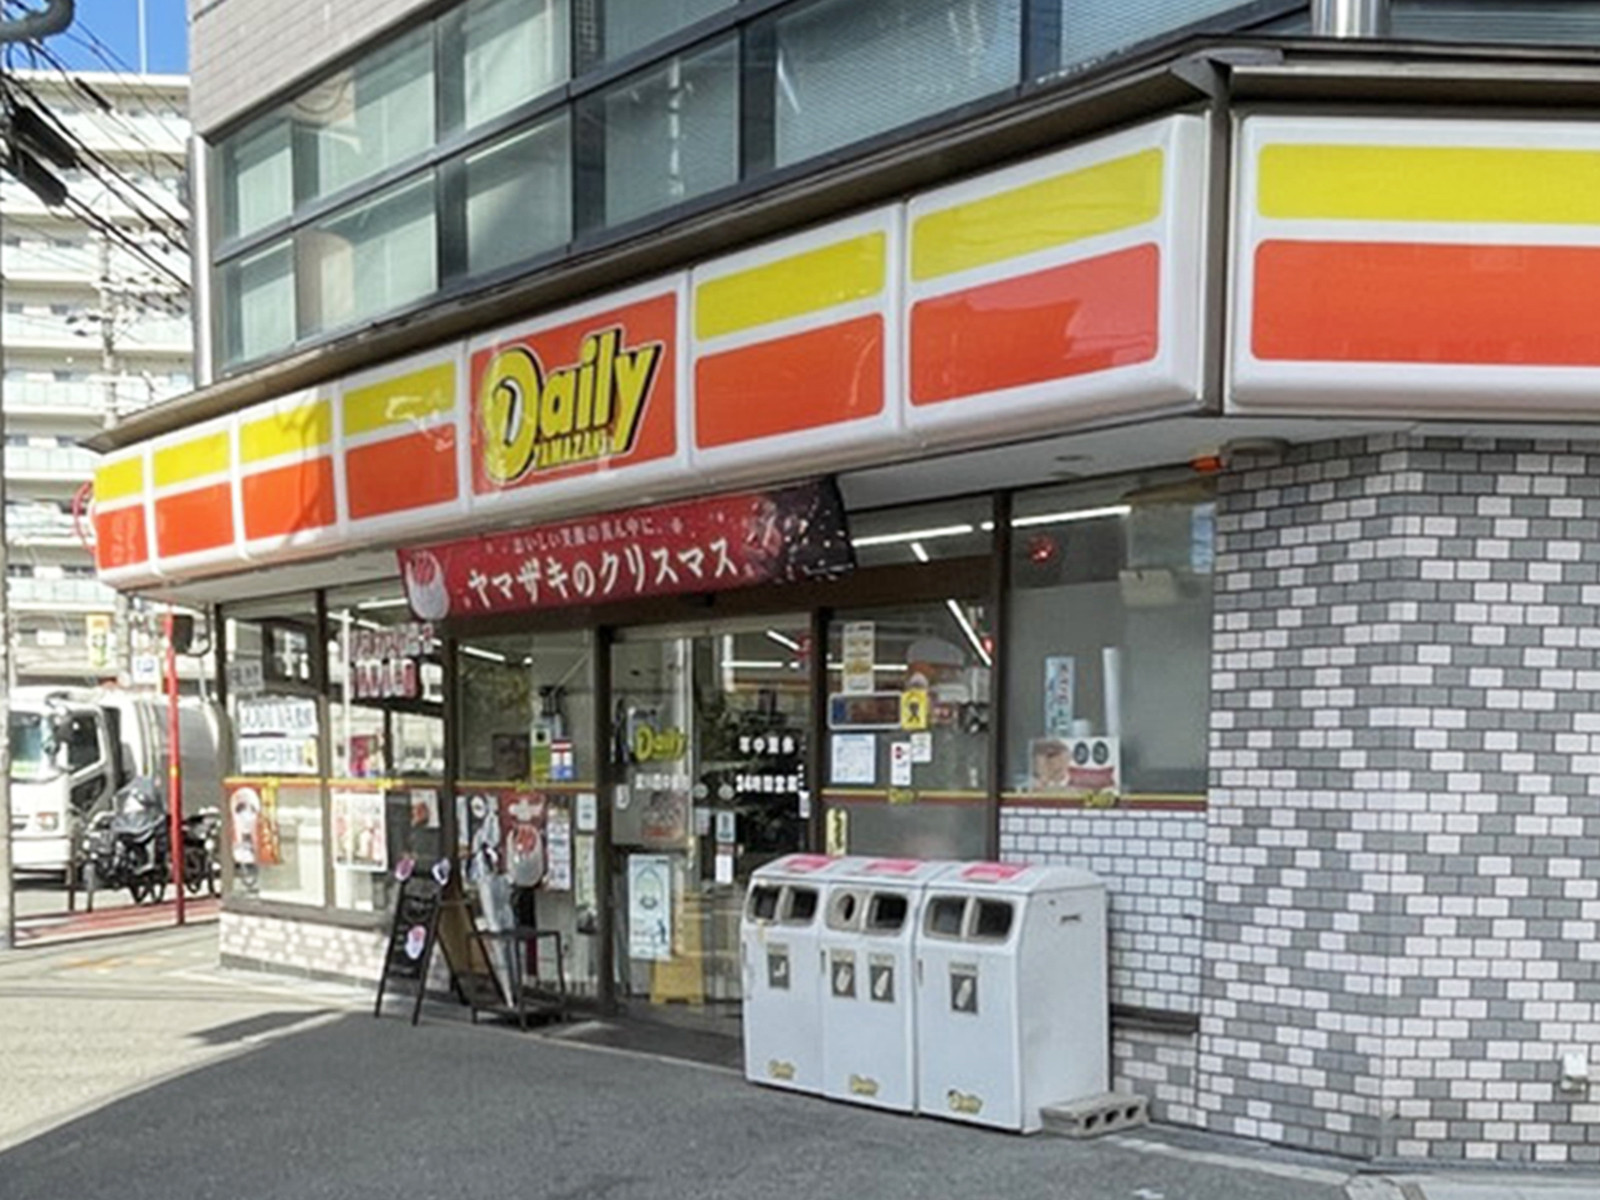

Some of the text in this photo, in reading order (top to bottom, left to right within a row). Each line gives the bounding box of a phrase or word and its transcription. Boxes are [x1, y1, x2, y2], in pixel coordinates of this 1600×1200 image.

[482, 325, 662, 482] Daily
[467, 537, 740, 608] ヤマザキのクリスマス
[635, 721, 686, 762] Daily
